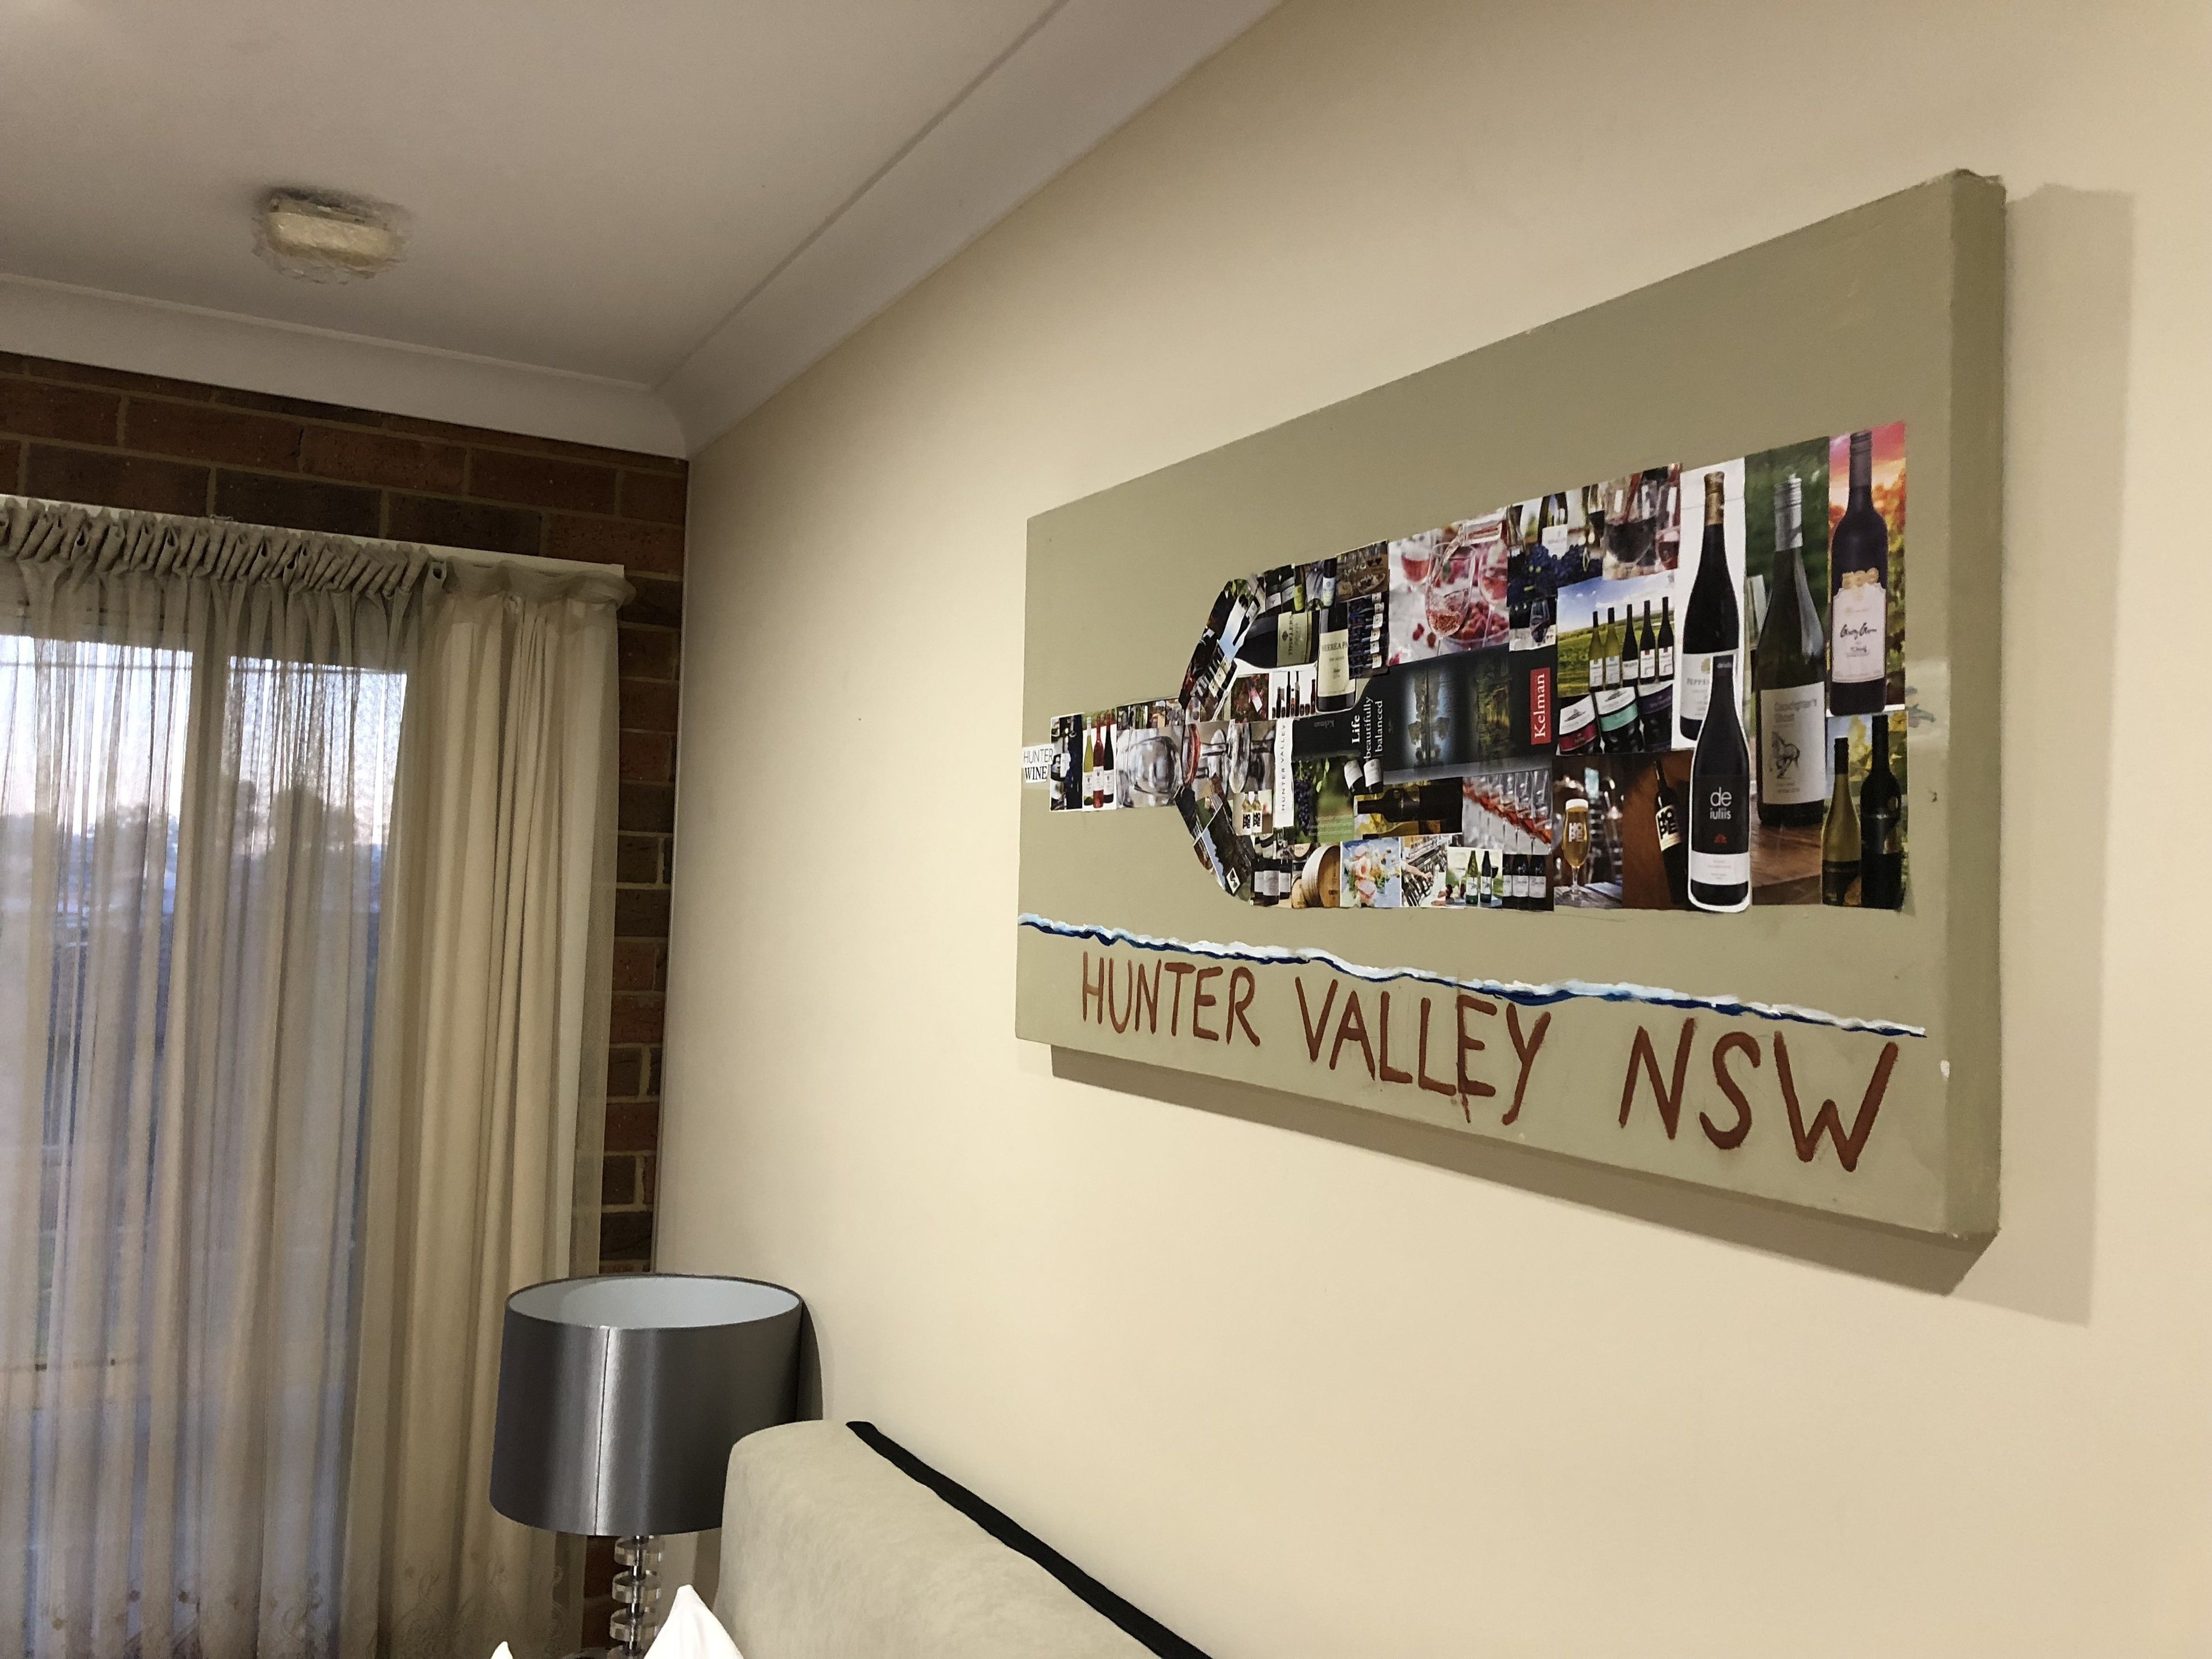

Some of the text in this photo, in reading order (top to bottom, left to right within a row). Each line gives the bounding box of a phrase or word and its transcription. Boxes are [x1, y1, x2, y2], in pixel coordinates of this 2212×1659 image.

[1533, 673, 1546, 737] Kelman
[1351, 715, 1360, 744] Life
[1363, 696, 1373, 759] beautifully
[1374, 700, 1382, 752] balanced
[1023, 748, 1054, 764] HUNTER
[1025, 766, 1047, 780] WINE
[1710, 786, 1732, 806] de
[1081, 951, 1899, 1172] HUNTER VALLEY NSW
